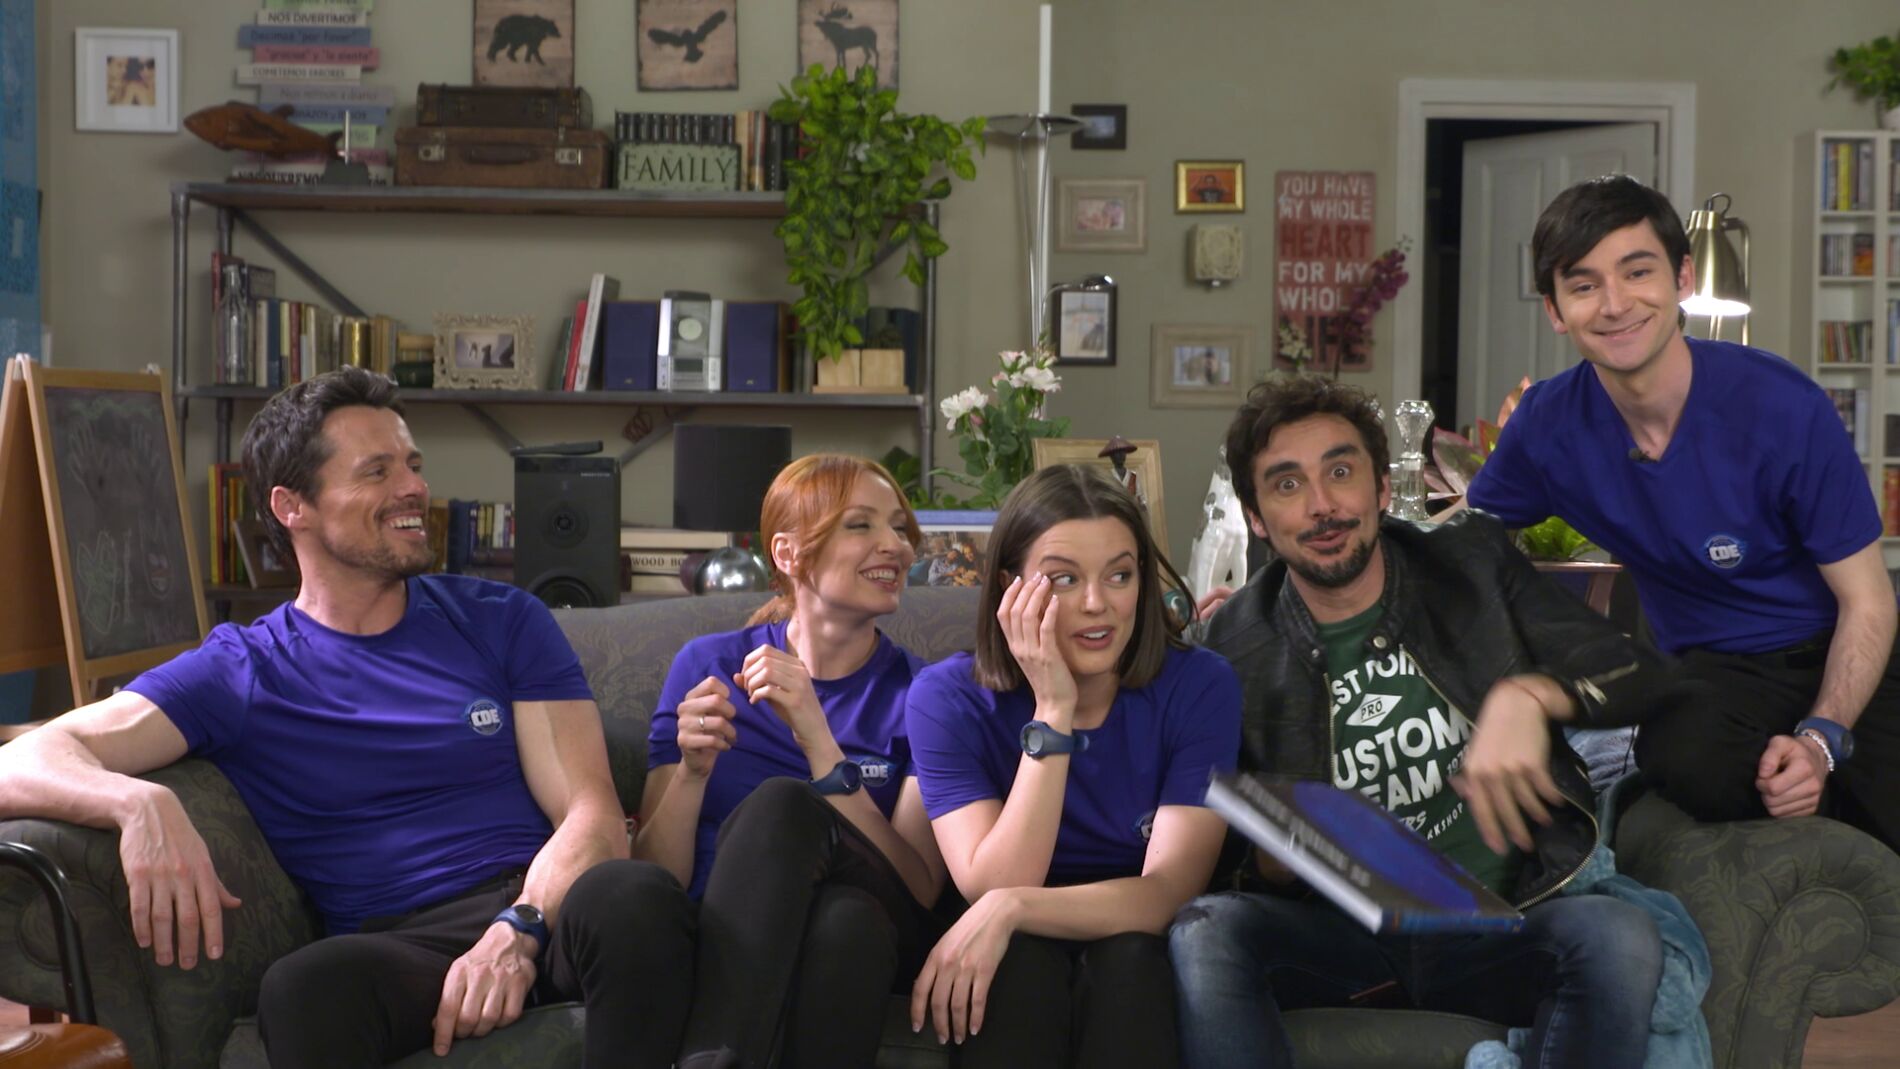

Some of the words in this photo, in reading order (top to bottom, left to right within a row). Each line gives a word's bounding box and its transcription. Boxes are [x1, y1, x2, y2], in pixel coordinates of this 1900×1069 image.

[268, 12, 290, 23] NOS
[293, 12, 357, 24] DIVERTIMOS
[252, 68, 306, 77] COMETEMOS
[309, 69, 345, 78] ERRORES
[623, 152, 733, 183] FAMILY
[1281, 176, 1316, 197] YOU
[1323, 176, 1371, 197] HAVE
[1278, 197, 1303, 219] MY
[1311, 199, 1371, 220] WHOLE
[1278, 224, 1371, 258] HEART
[1278, 261, 1325, 283] FOR
[1335, 261, 1370, 283] MY
[1278, 287, 1351, 312] WHOL
[632, 557, 665, 567] WOOD
[471, 709, 501, 727] CDE
[1360, 701, 1384, 719] PRO
[1334, 704, 1470, 791] USTOM
[1359, 759, 1443, 812] EAM
